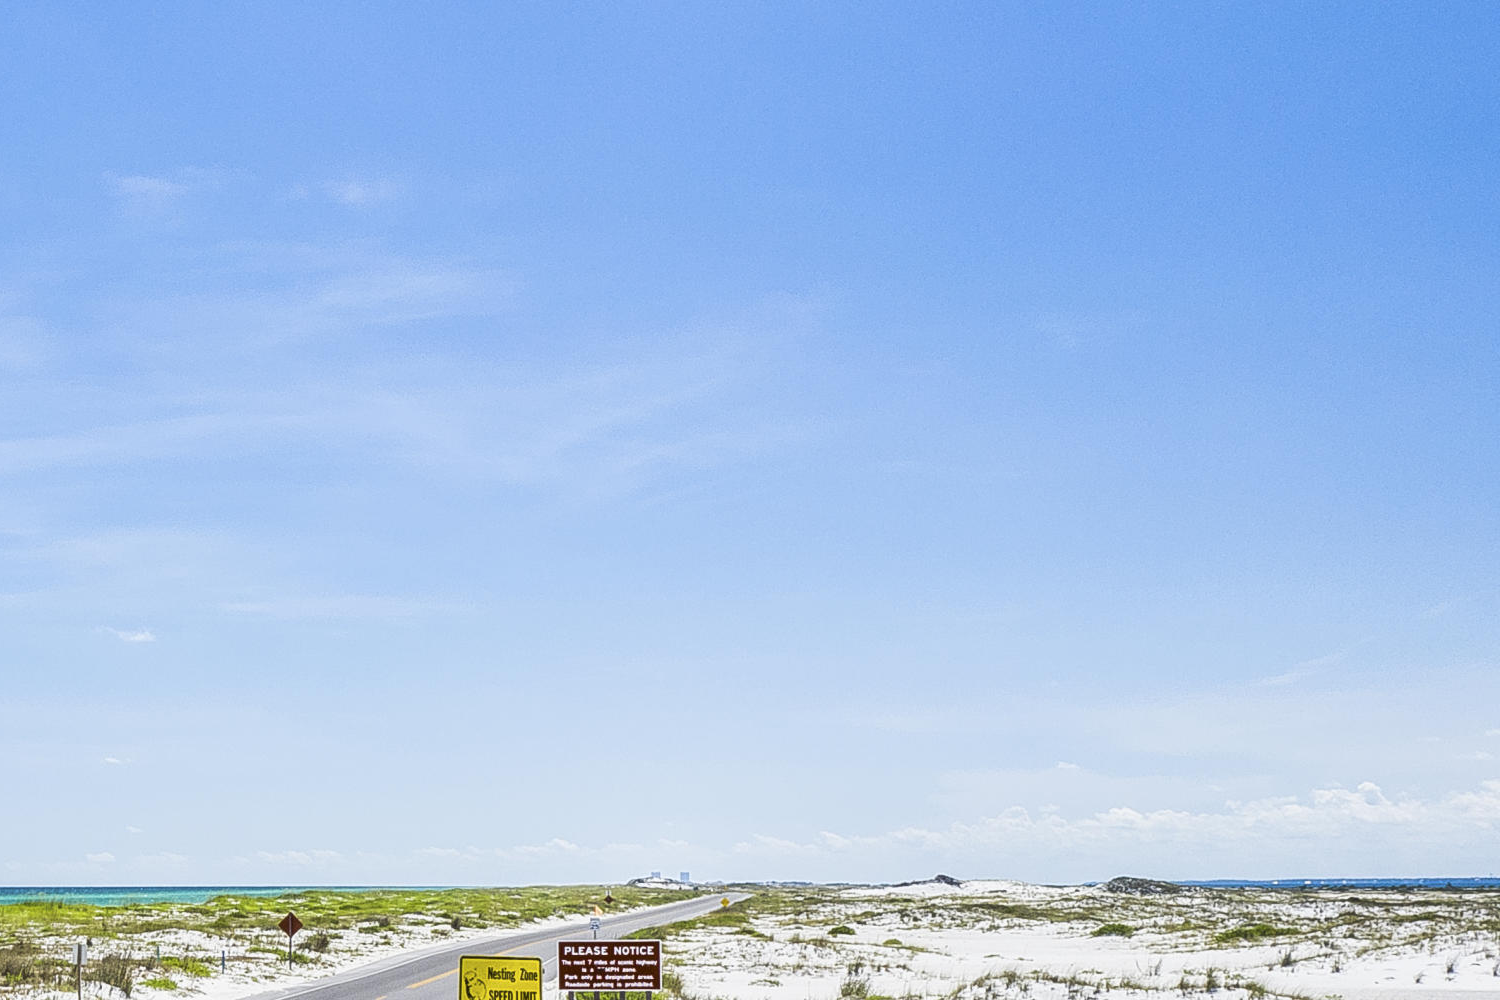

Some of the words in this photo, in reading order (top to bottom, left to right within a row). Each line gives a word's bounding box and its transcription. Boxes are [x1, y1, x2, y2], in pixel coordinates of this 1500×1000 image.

[564, 946, 608, 955] PLEASE
[613, 946, 654, 955] NOTICE
[488, 967, 516, 982] Nesting
[520, 967, 538, 981] Zone
